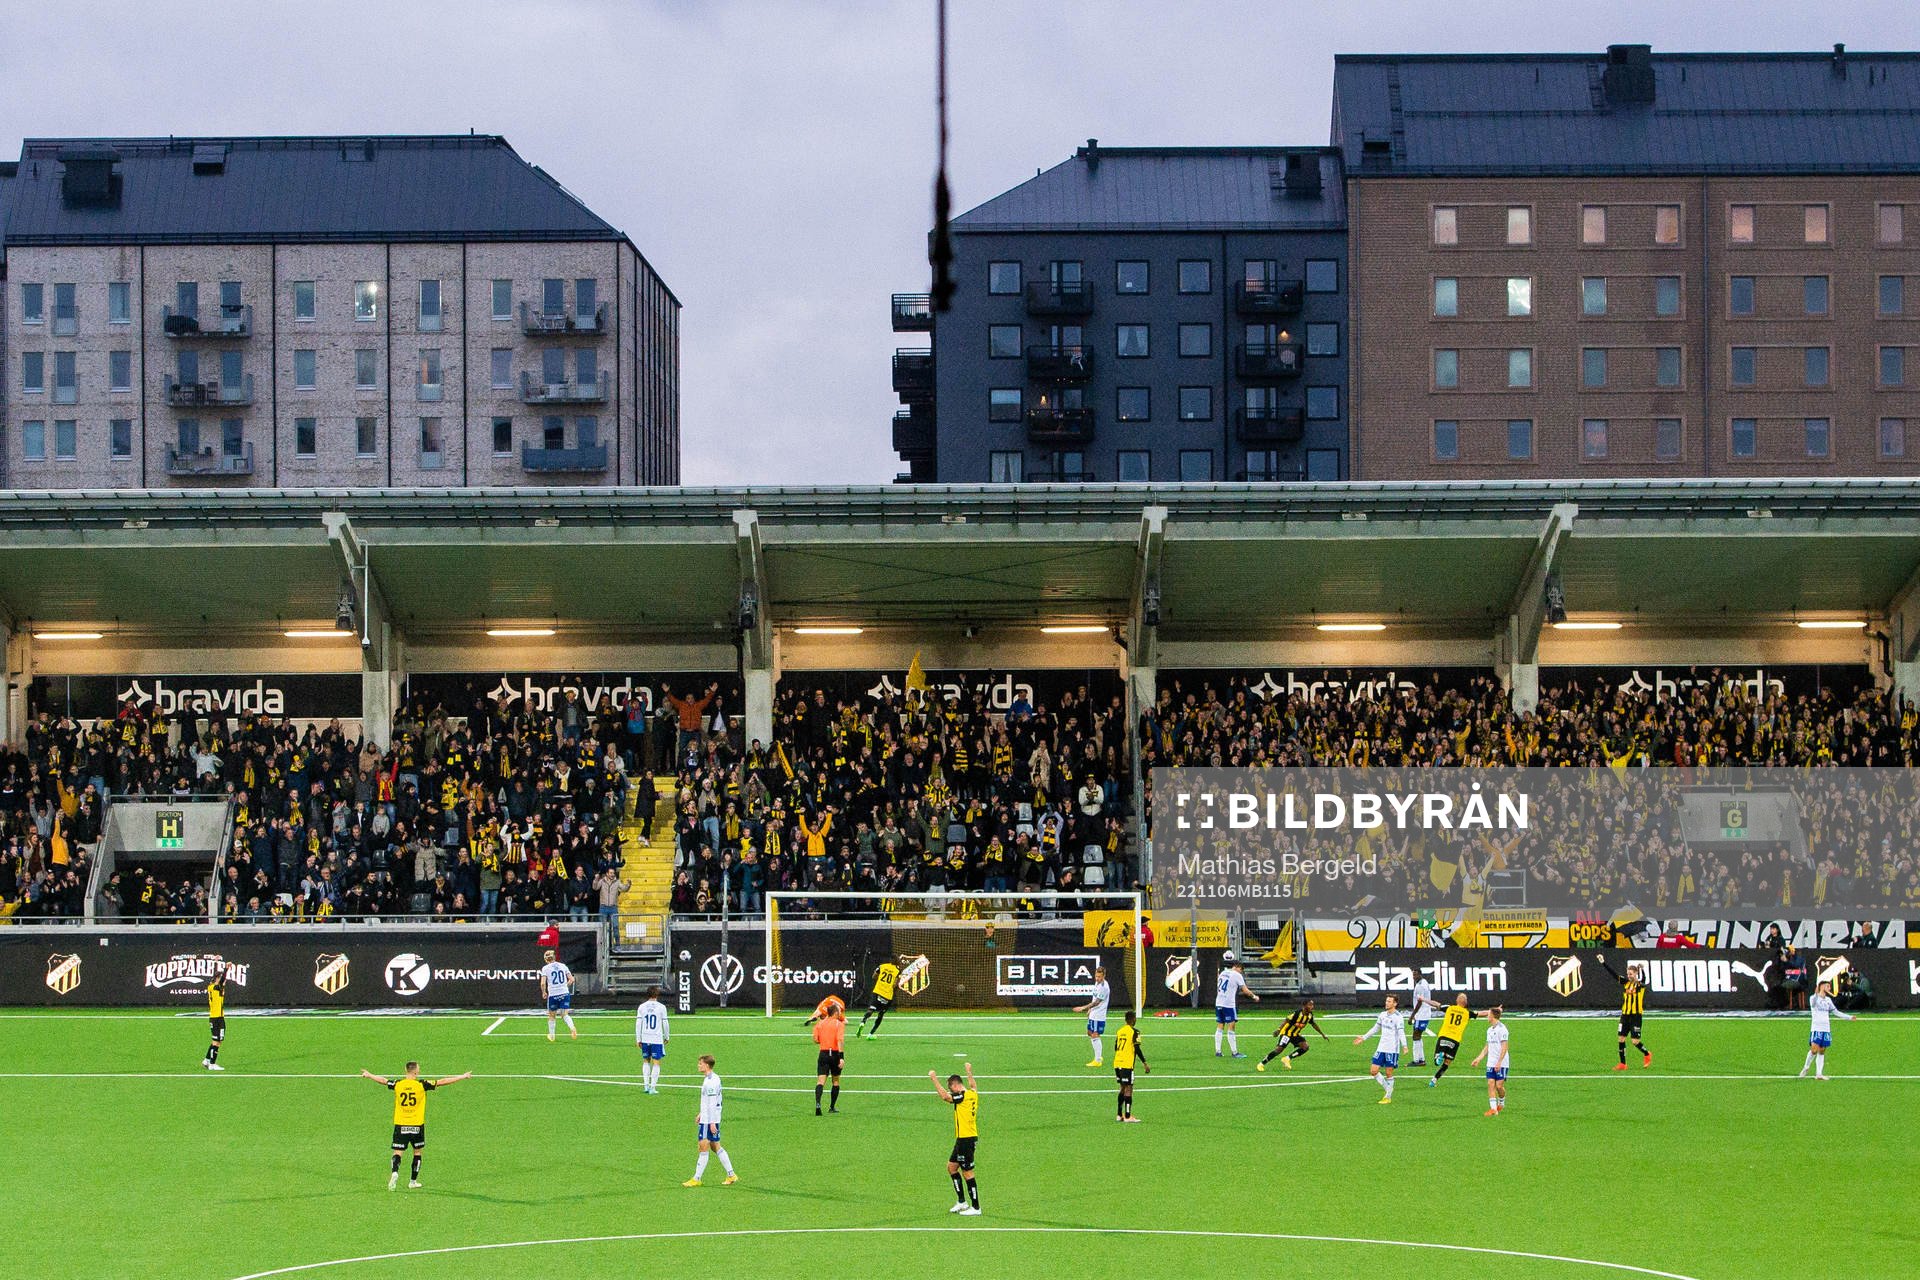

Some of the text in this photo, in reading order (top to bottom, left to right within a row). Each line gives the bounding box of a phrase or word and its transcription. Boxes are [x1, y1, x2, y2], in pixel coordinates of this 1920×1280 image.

[155, 679, 285, 715] bravida
[1726, 809, 1743, 827] G
[162, 819, 178, 837] H
[1576, 911, 1605, 926] ALL
[1570, 924, 1611, 942] COPS
[551, 970, 565, 985] 20
[881, 971, 893, 984] 20
[1355, 961, 1507, 991] stadium
[679, 970, 691, 1012] SELECT
[644, 1015, 657, 1029] 10
[1449, 1013, 1462, 1025] 18
[400, 1092, 417, 1106] 25
